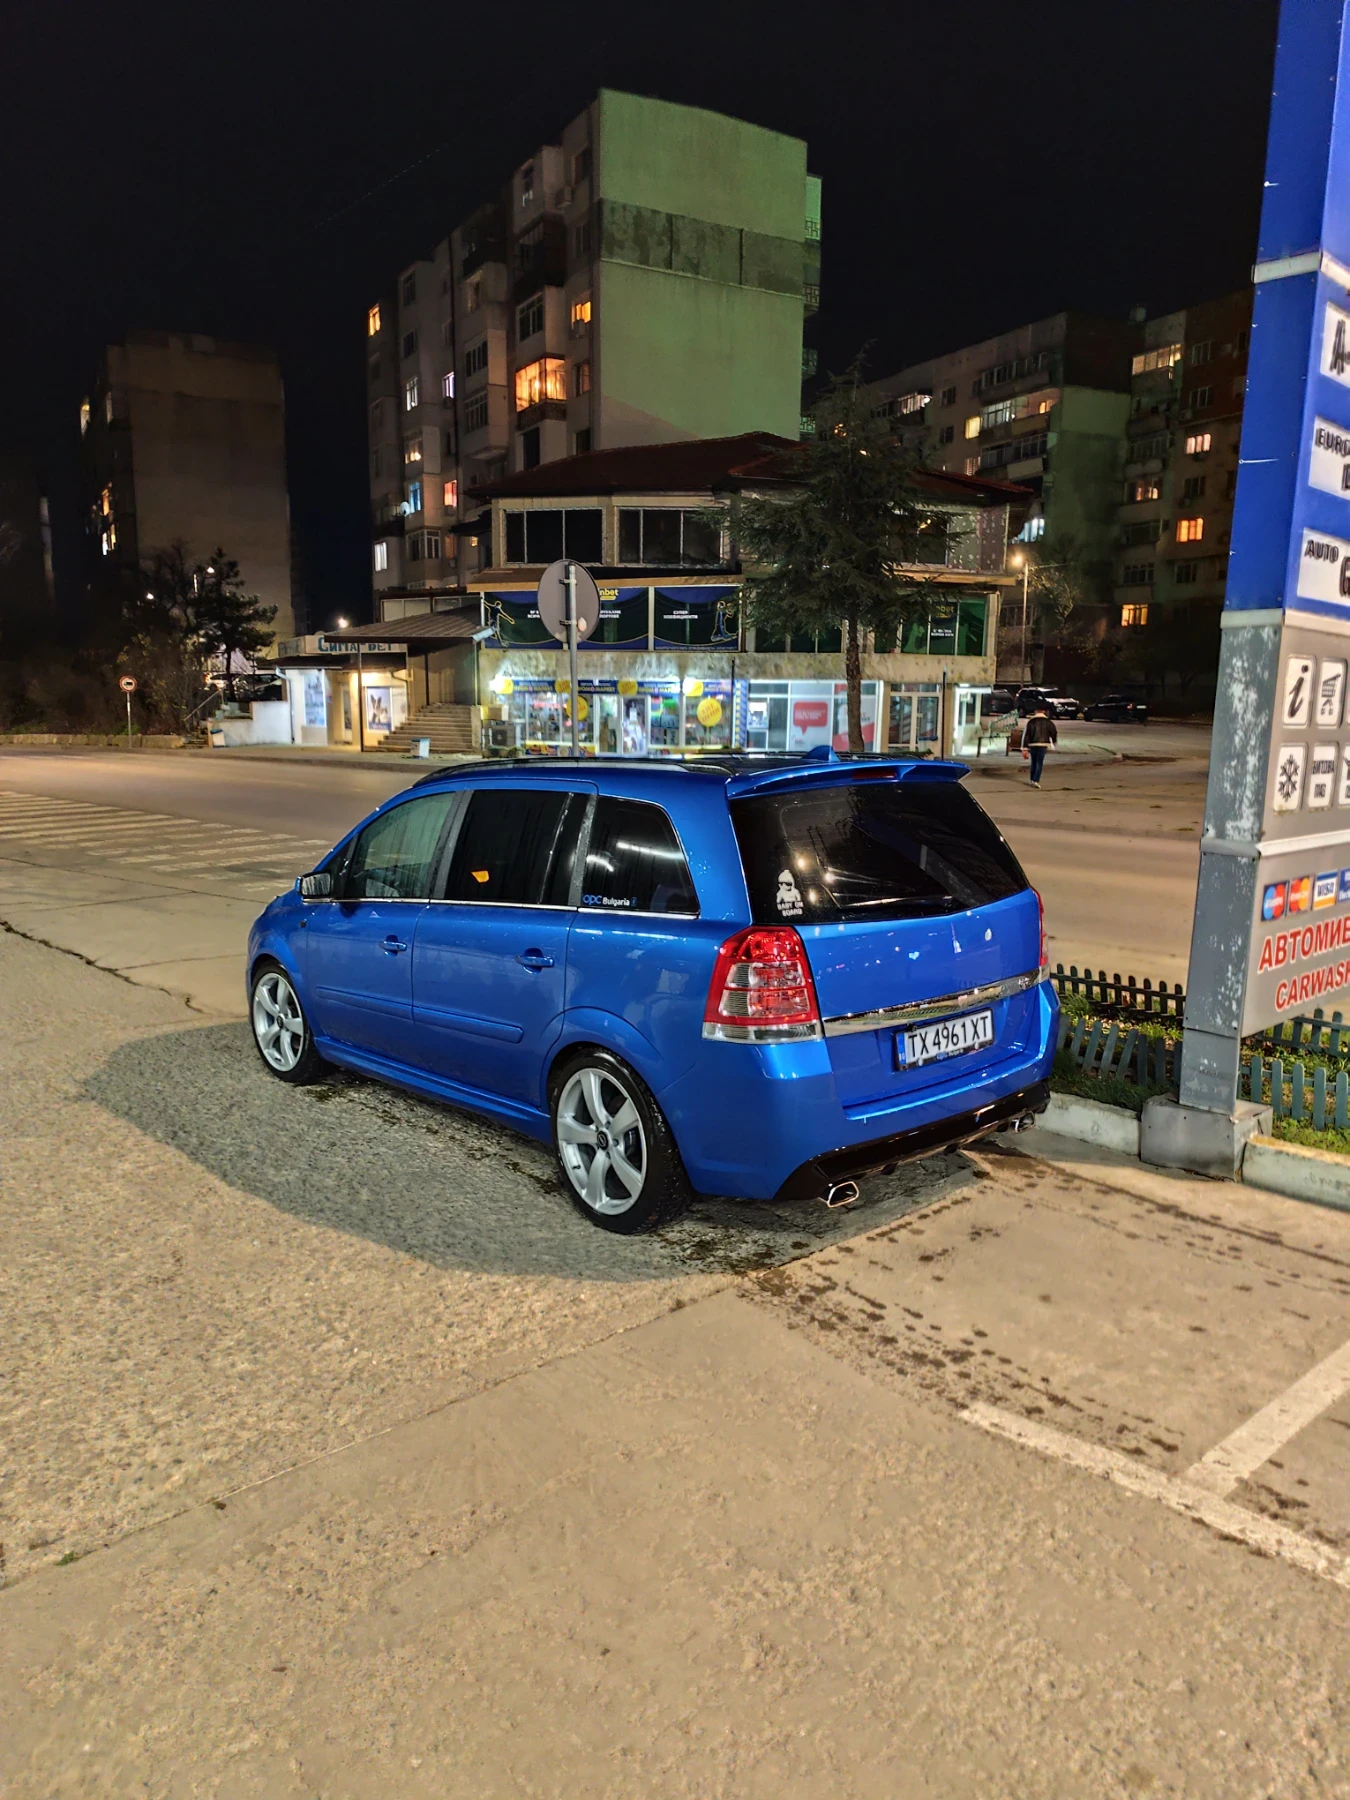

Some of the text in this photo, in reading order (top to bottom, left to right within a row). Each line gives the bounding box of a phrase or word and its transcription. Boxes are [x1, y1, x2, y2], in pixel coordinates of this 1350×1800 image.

[1304, 539, 1339, 563] AUTO
[1317, 882, 1335, 897] VISA
[602, 896, 630, 907] Bulgaria
